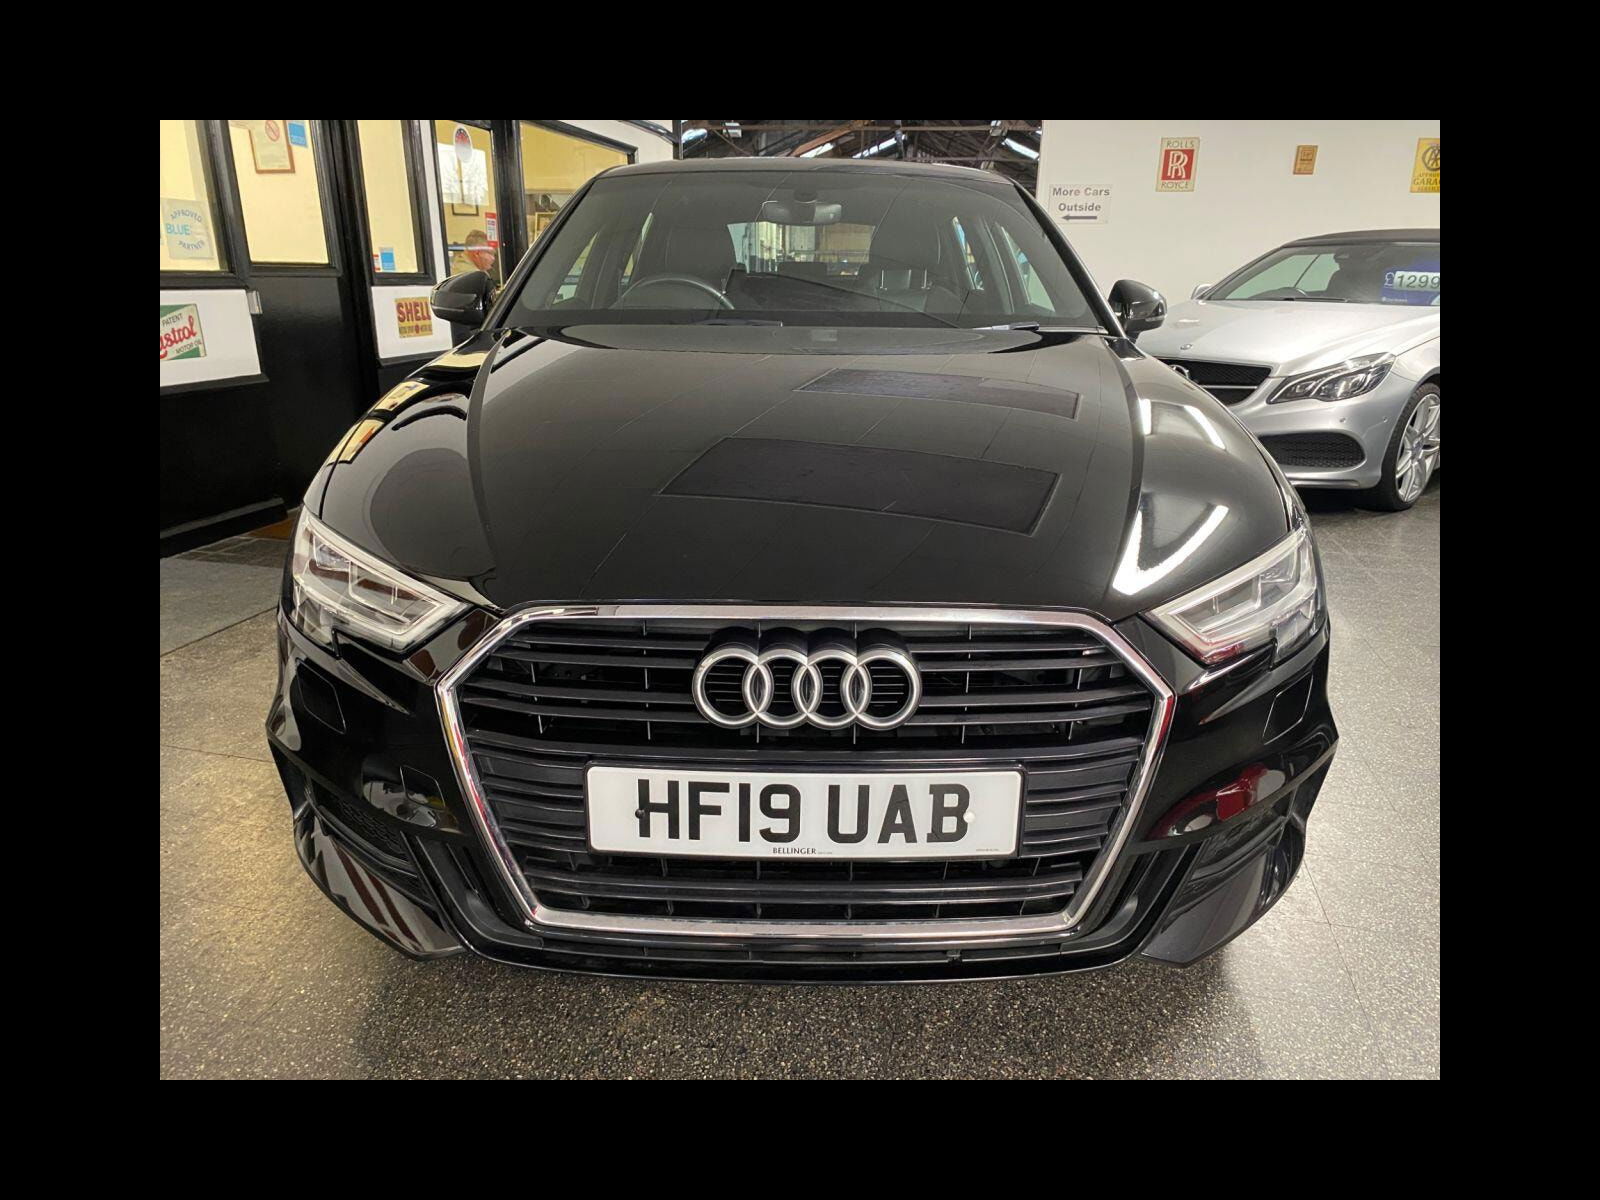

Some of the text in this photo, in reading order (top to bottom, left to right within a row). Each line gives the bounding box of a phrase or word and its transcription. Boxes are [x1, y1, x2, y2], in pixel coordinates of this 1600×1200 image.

[1166, 140, 1195, 149] ROLLS
[1160, 181, 1190, 190] ROYCE
[1413, 177, 1440, 186] GARA
[1052, 187, 1111, 197] More Cars
[1058, 202, 1102, 212] Outside
[166, 223, 191, 236] BLUE
[396, 301, 431, 322] SHELL
[162, 313, 183, 327] PATENT
[636, 778, 970, 844] HF19 UAB
[772, 847, 817, 855] BELLINGER
